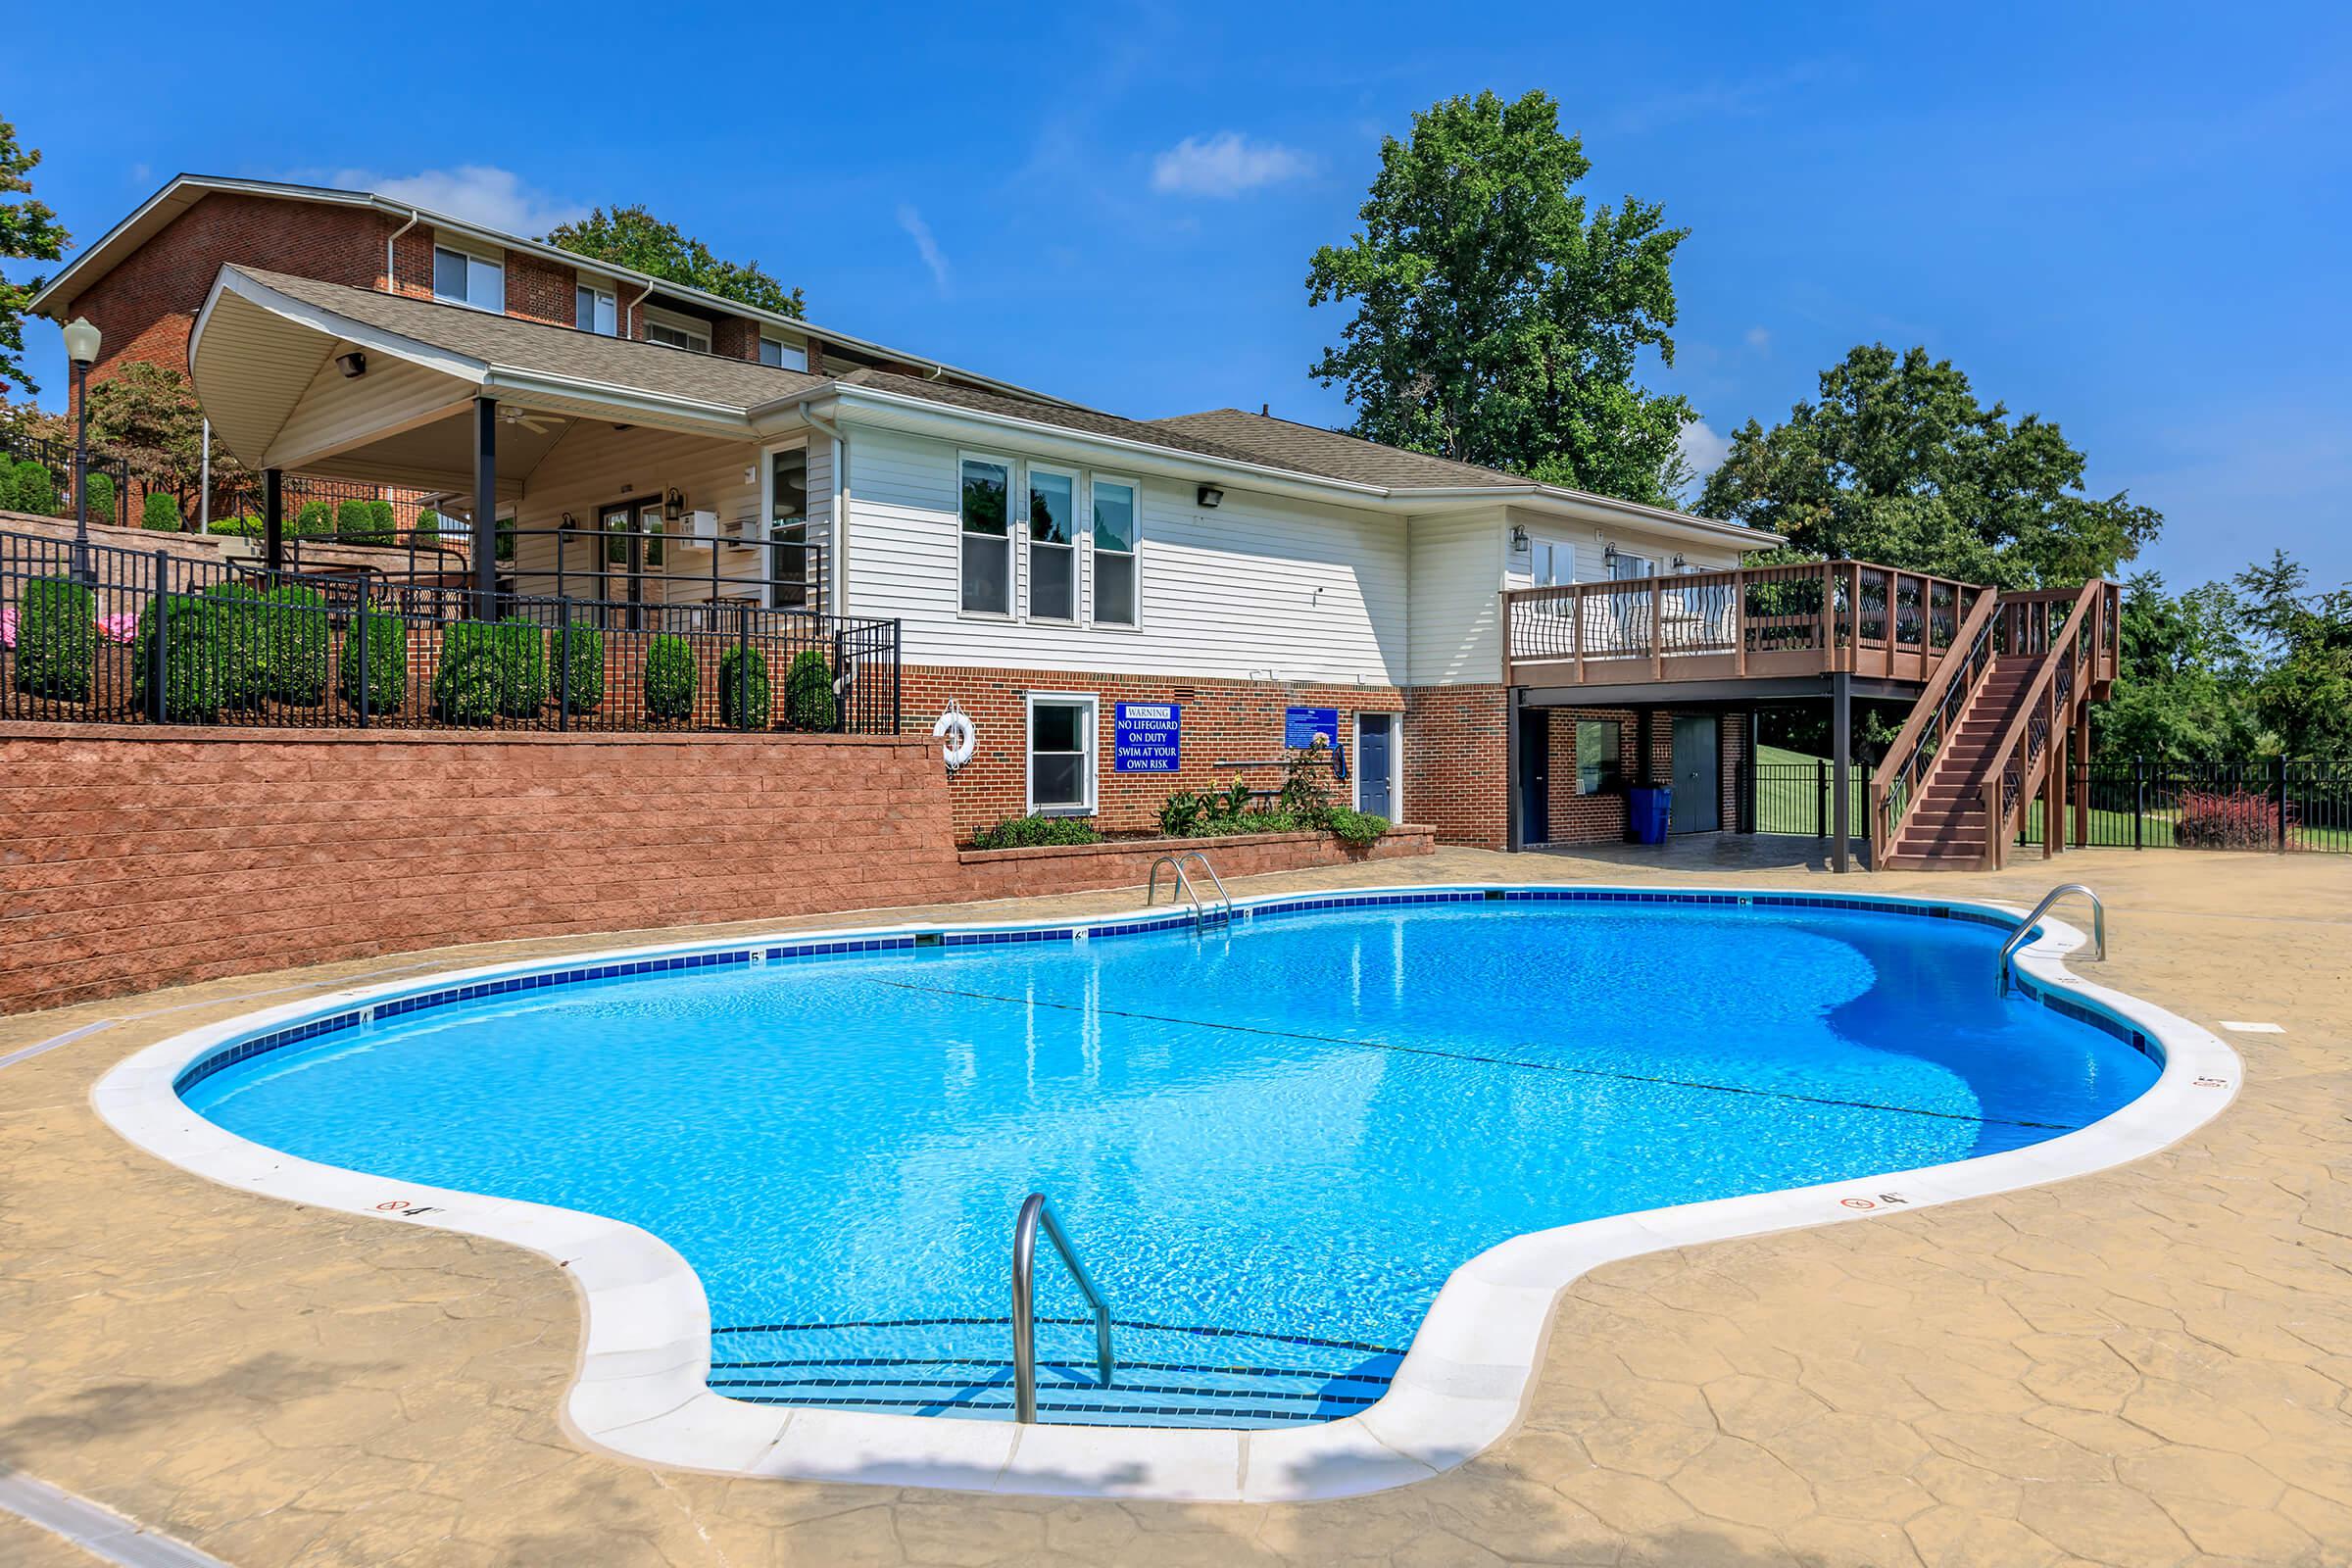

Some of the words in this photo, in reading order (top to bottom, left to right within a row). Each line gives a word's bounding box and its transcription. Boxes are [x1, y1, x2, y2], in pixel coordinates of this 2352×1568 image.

[1128, 708, 1168, 717] WARNING
[1118, 720, 1132, 729] NO
[1134, 720, 1178, 730] LIFEGUARD
[1129, 732, 1142, 742] ON
[1145, 733, 1167, 742] DUTY
[1118, 747, 1141, 757] SWIM
[1142, 747, 1153, 757] AT
[1153, 747, 1177, 757] YOUR
[1127, 760, 1148, 768] OWN
[1150, 760, 1168, 769] RISK
